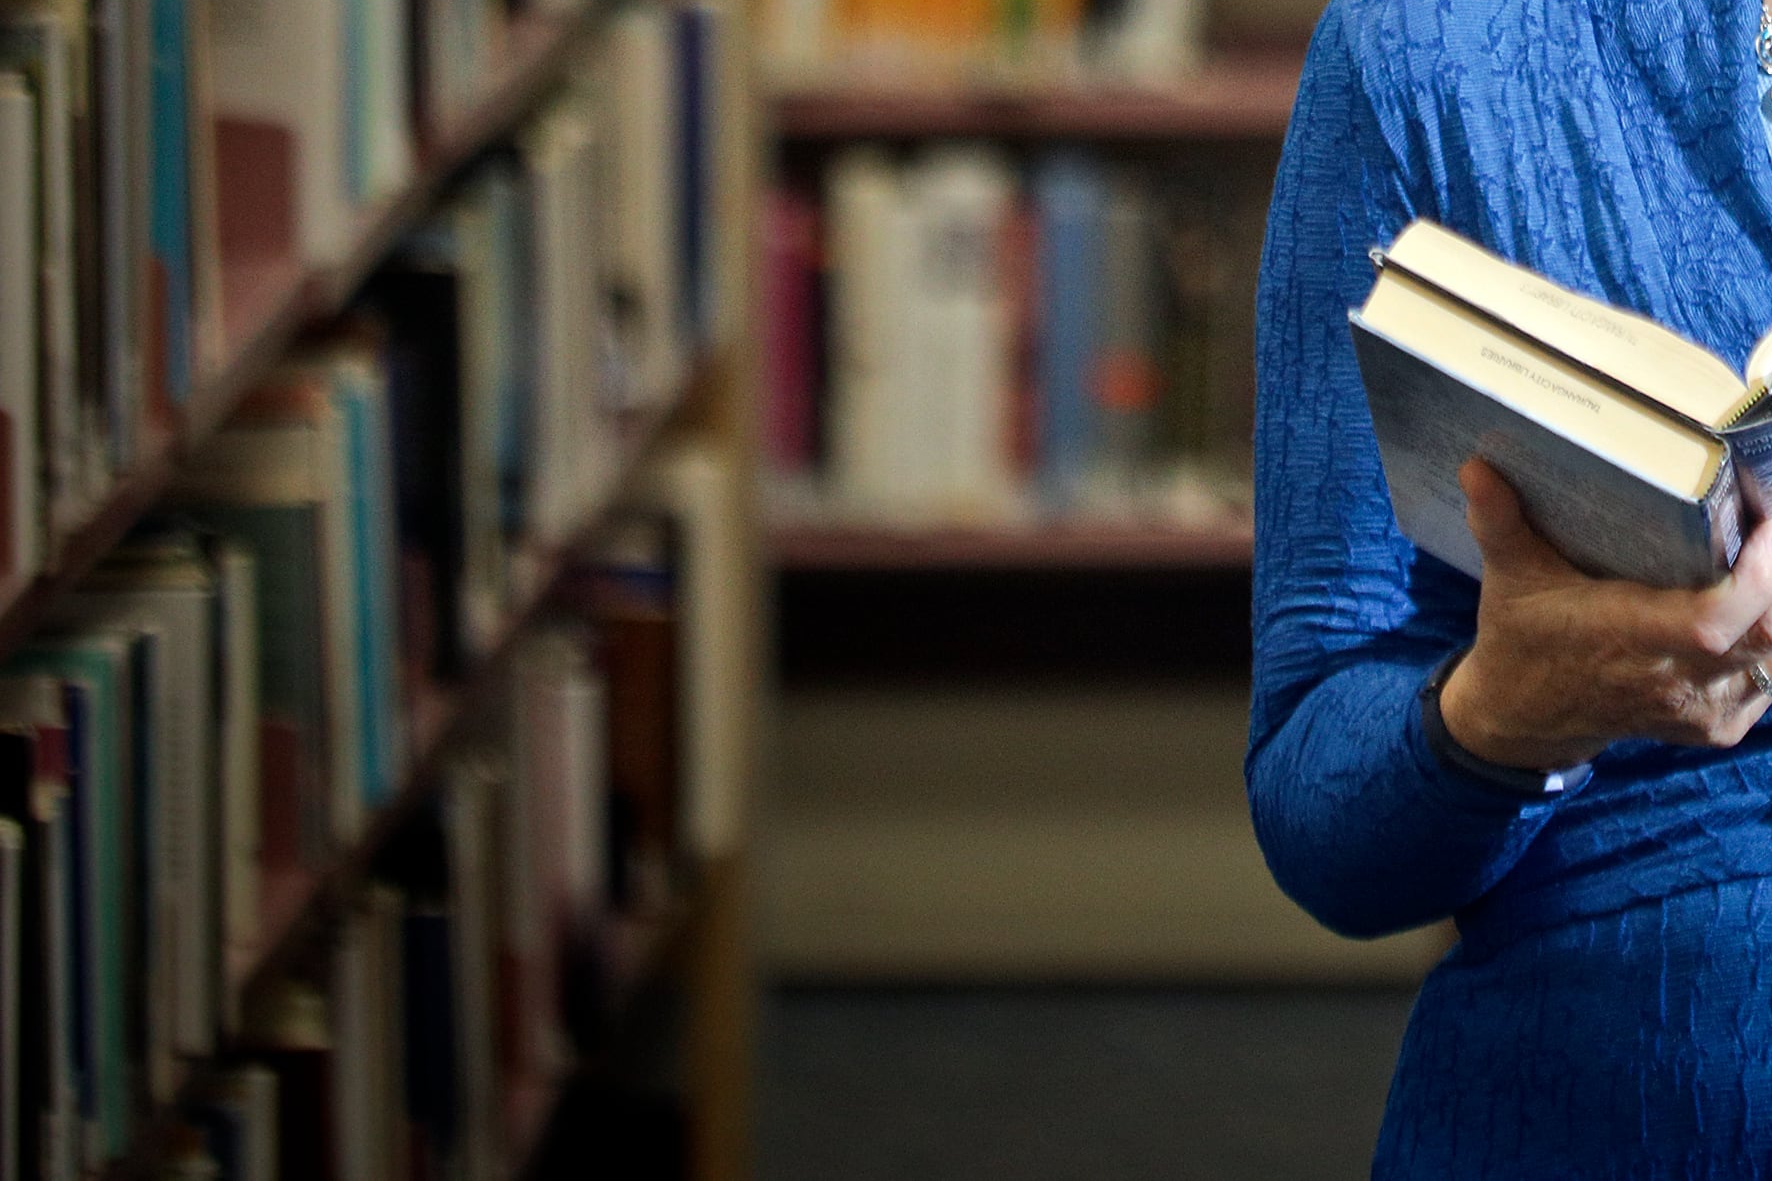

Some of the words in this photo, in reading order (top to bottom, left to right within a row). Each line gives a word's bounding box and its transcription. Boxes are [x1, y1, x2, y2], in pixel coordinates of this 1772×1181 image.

[1480, 347, 1528, 378] LIBRARIES
[1531, 372, 1551, 389] CITY
[1550, 383, 1600, 415] TAURANGA
